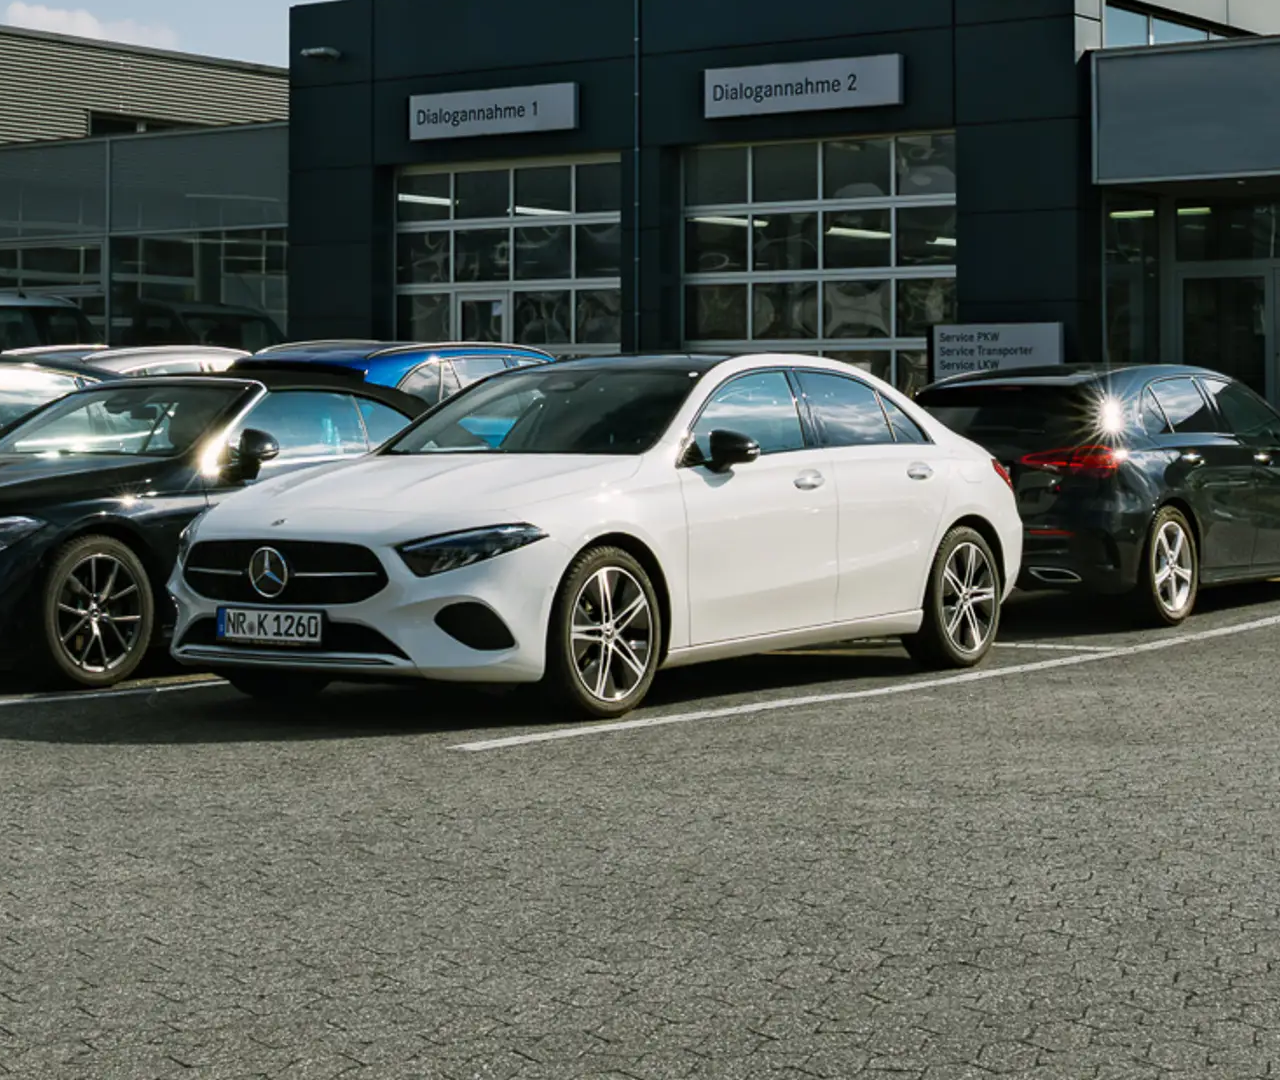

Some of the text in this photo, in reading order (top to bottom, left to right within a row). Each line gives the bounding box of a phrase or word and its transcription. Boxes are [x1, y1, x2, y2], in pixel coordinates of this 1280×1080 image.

[712, 74, 857, 103] Dialogannahme 2
[416, 101, 538, 126] Dialogannahme 1
[939, 331, 1000, 342] Service PKW
[939, 345, 1034, 358] Service Transporter
[939, 359, 1000, 370] Service LKW
[225, 612, 319, 638] NR K 1260
